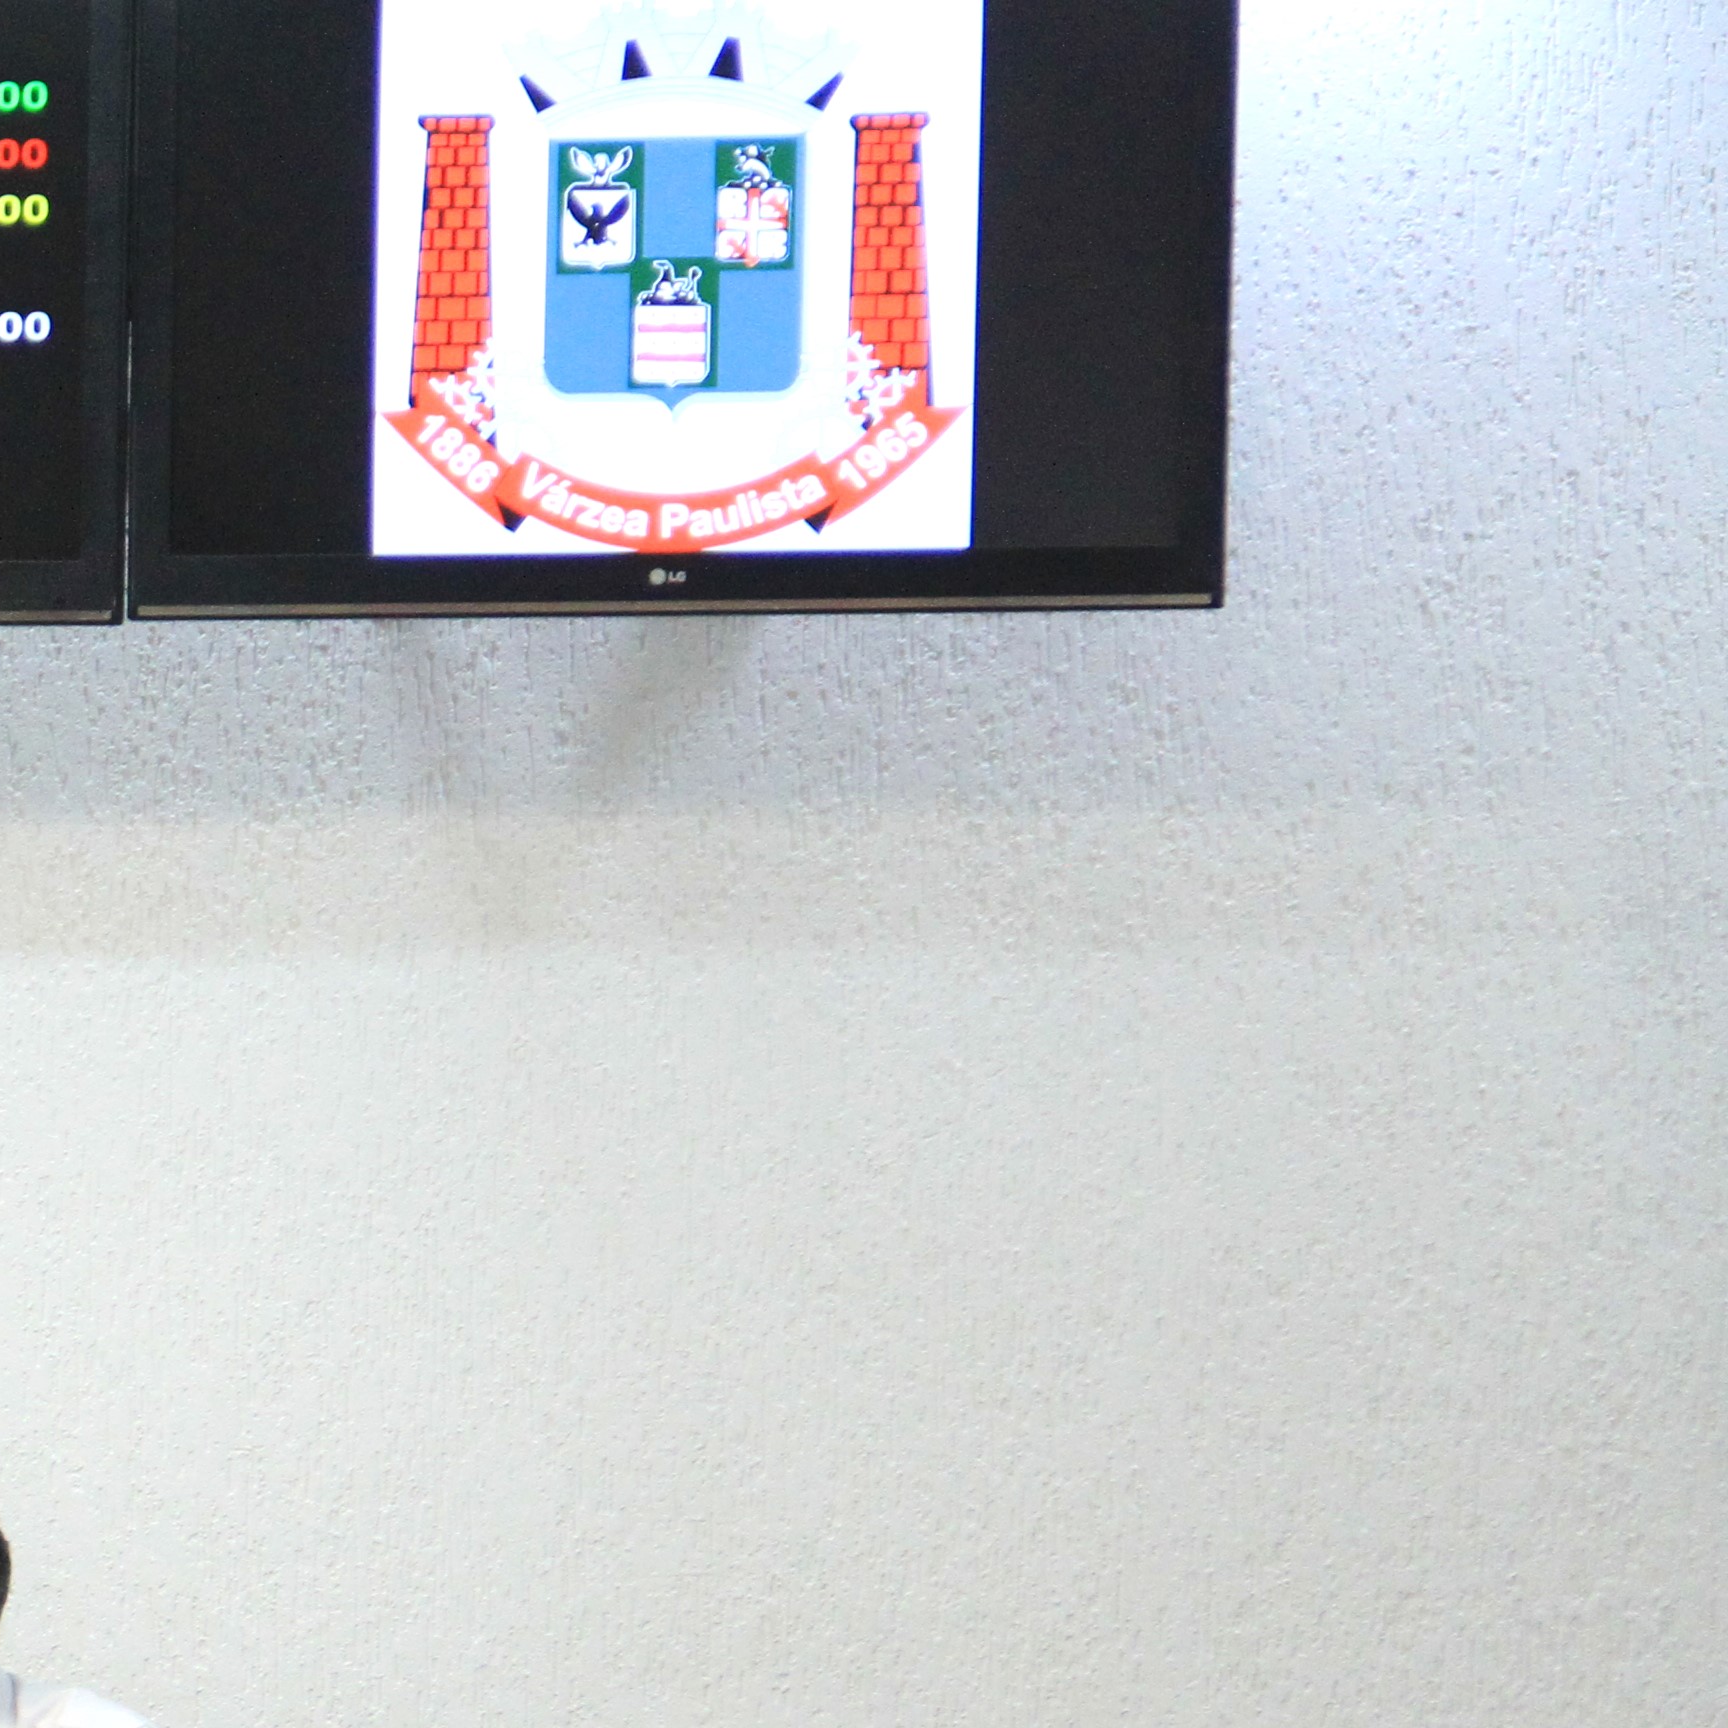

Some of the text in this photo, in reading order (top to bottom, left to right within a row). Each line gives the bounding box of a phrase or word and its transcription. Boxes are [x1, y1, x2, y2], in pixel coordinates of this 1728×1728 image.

[416, 413, 499, 493] 1886
[837, 411, 928, 491] 1965
[520, 461, 827, 539] Várzea Paulista
